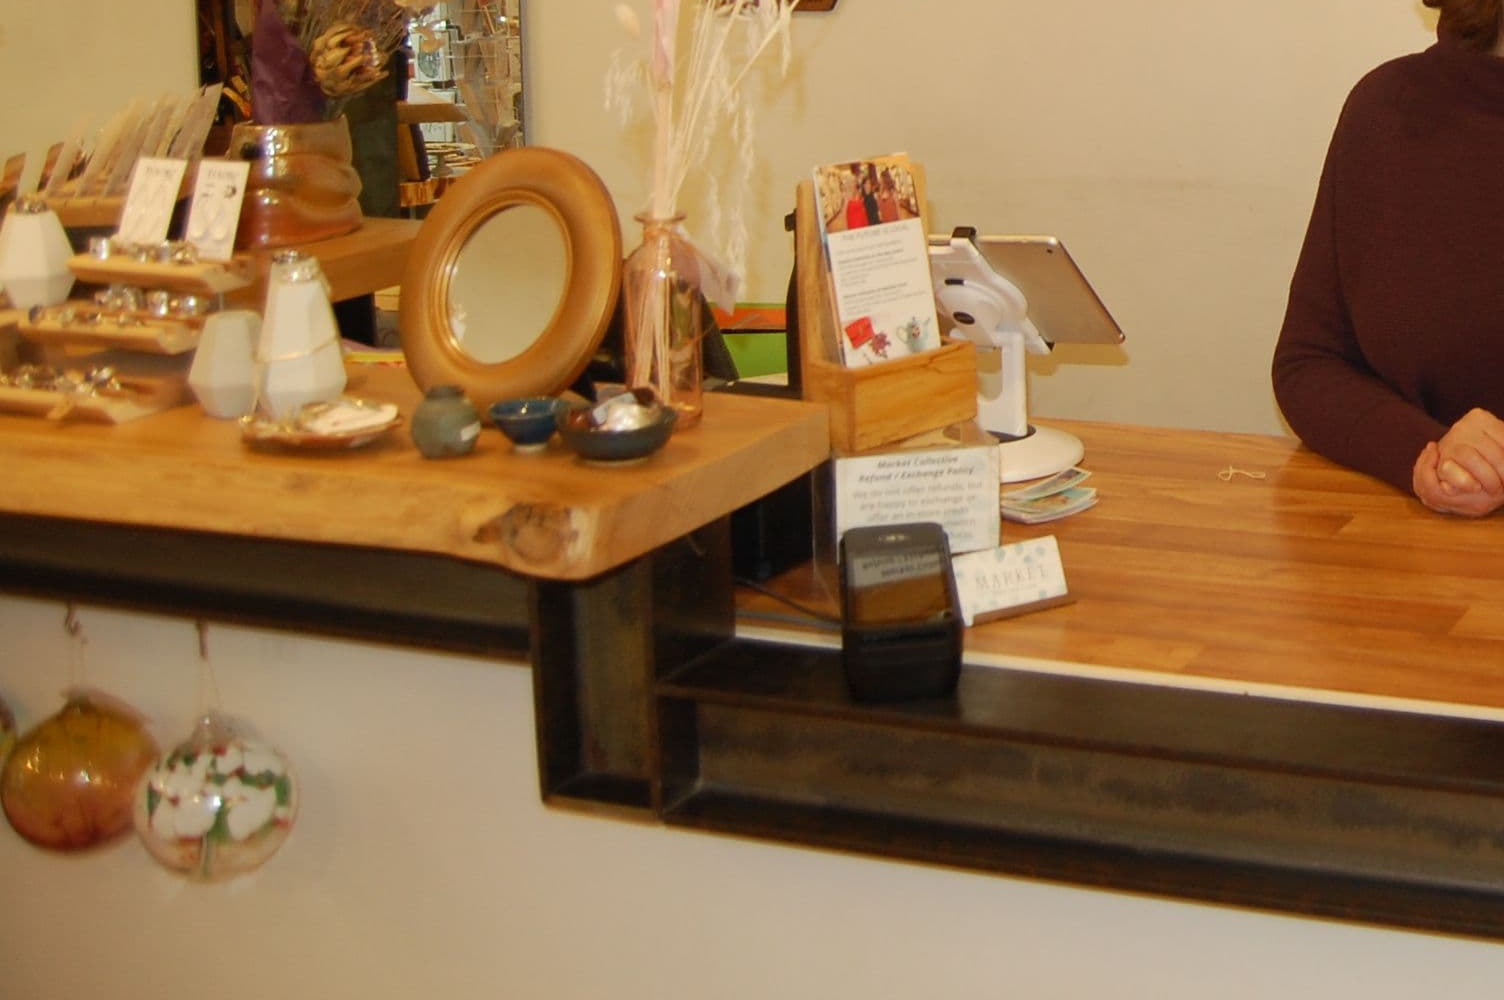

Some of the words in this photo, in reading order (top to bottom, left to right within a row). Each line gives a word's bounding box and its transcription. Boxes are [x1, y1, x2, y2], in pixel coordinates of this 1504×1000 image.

[877, 458, 912, 469] Market
[914, 455, 959, 467] Collective
[858, 471, 893, 485] Refund
[900, 468, 944, 482] Exchange
[947, 465, 975, 477] Policy
